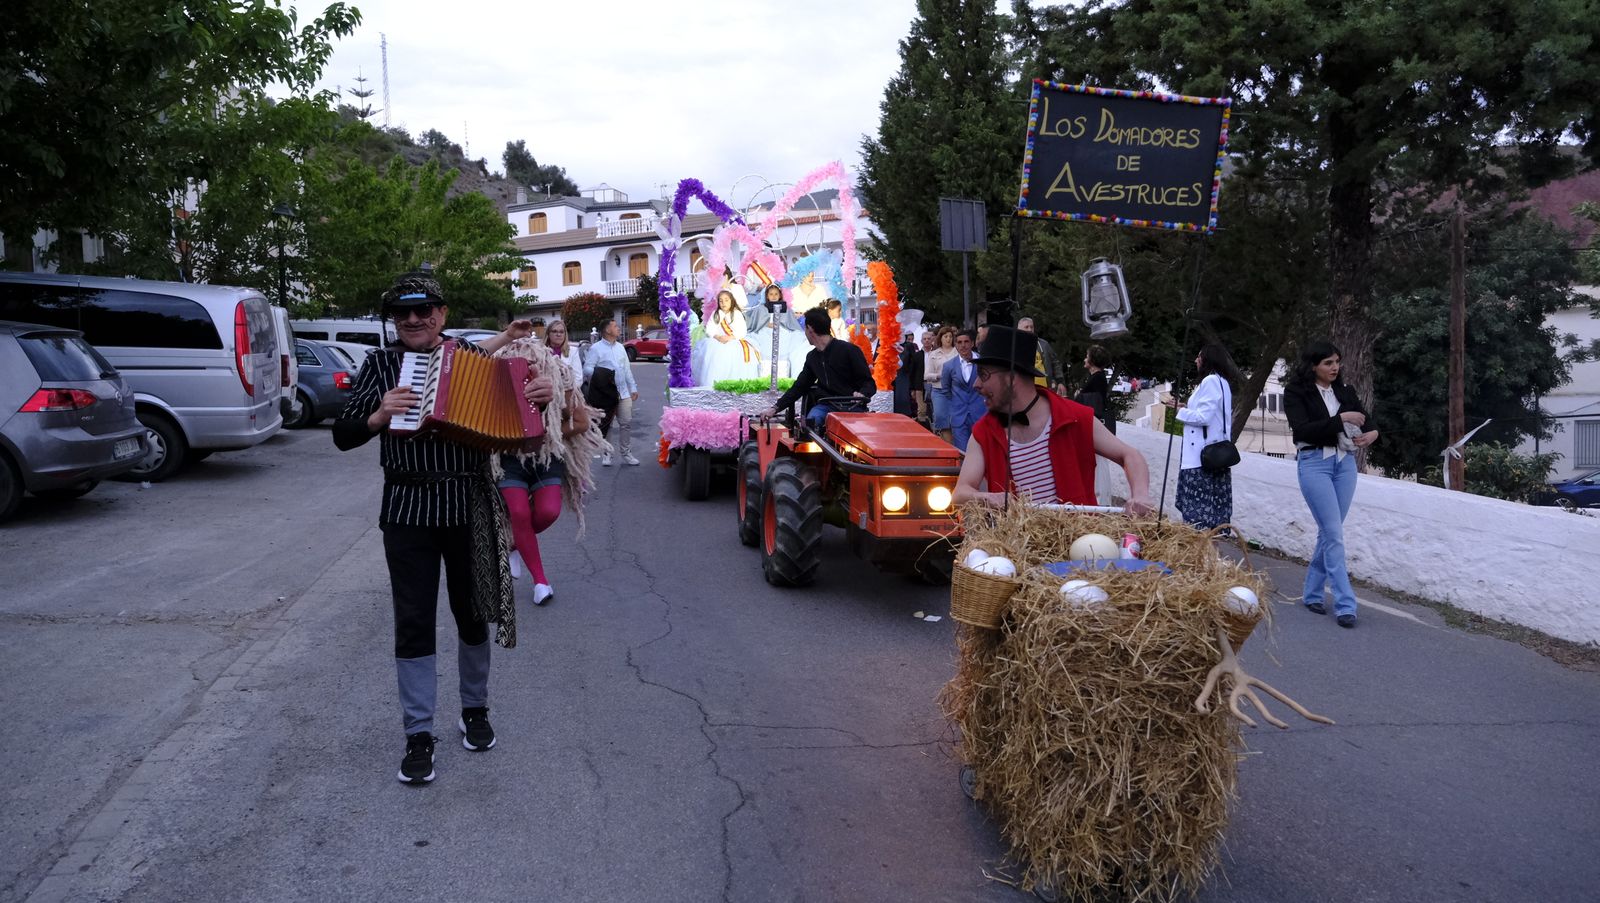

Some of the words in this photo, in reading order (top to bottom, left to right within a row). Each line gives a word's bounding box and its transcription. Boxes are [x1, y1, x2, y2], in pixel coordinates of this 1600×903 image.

[1039, 97, 1087, 139] LOS
[1093, 107, 1201, 149] DOMADORES
[1045, 162, 1203, 207] AVESTRUCES
[1116, 155, 1141, 171] DE
